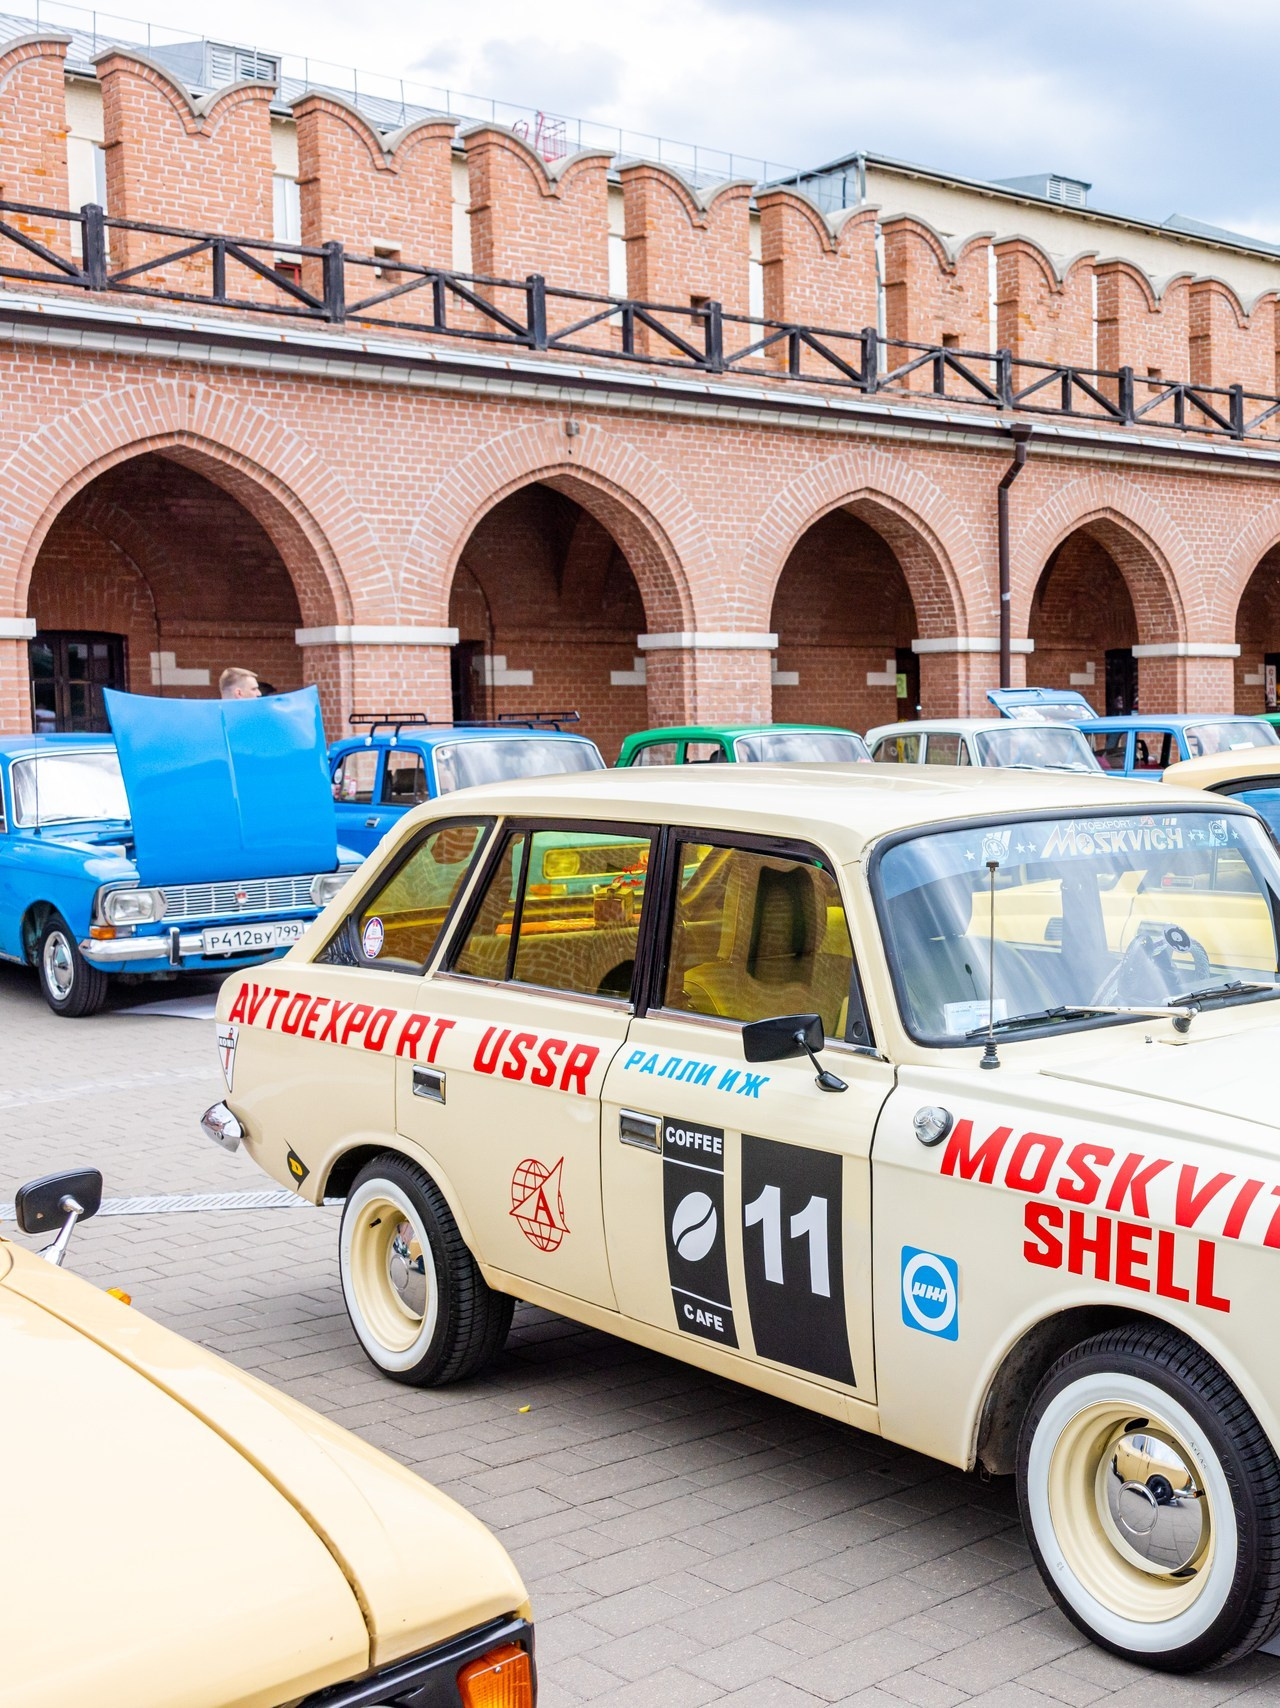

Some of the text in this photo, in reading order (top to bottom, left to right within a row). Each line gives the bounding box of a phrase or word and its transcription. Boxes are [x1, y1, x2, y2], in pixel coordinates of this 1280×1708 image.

[1040, 823, 1184, 858] MOSKVICH
[276, 925, 299, 938] 799
[228, 982, 600, 1095] AVTOEXPORT USSR
[624, 1050, 770, 1099] РАЛЛИ ИЖ
[665, 1126, 722, 1155] COFFEE
[745, 1184, 831, 1298] 11
[1023, 1200, 1231, 1313] SHELL
[684, 1304, 724, 1333] CAFE
